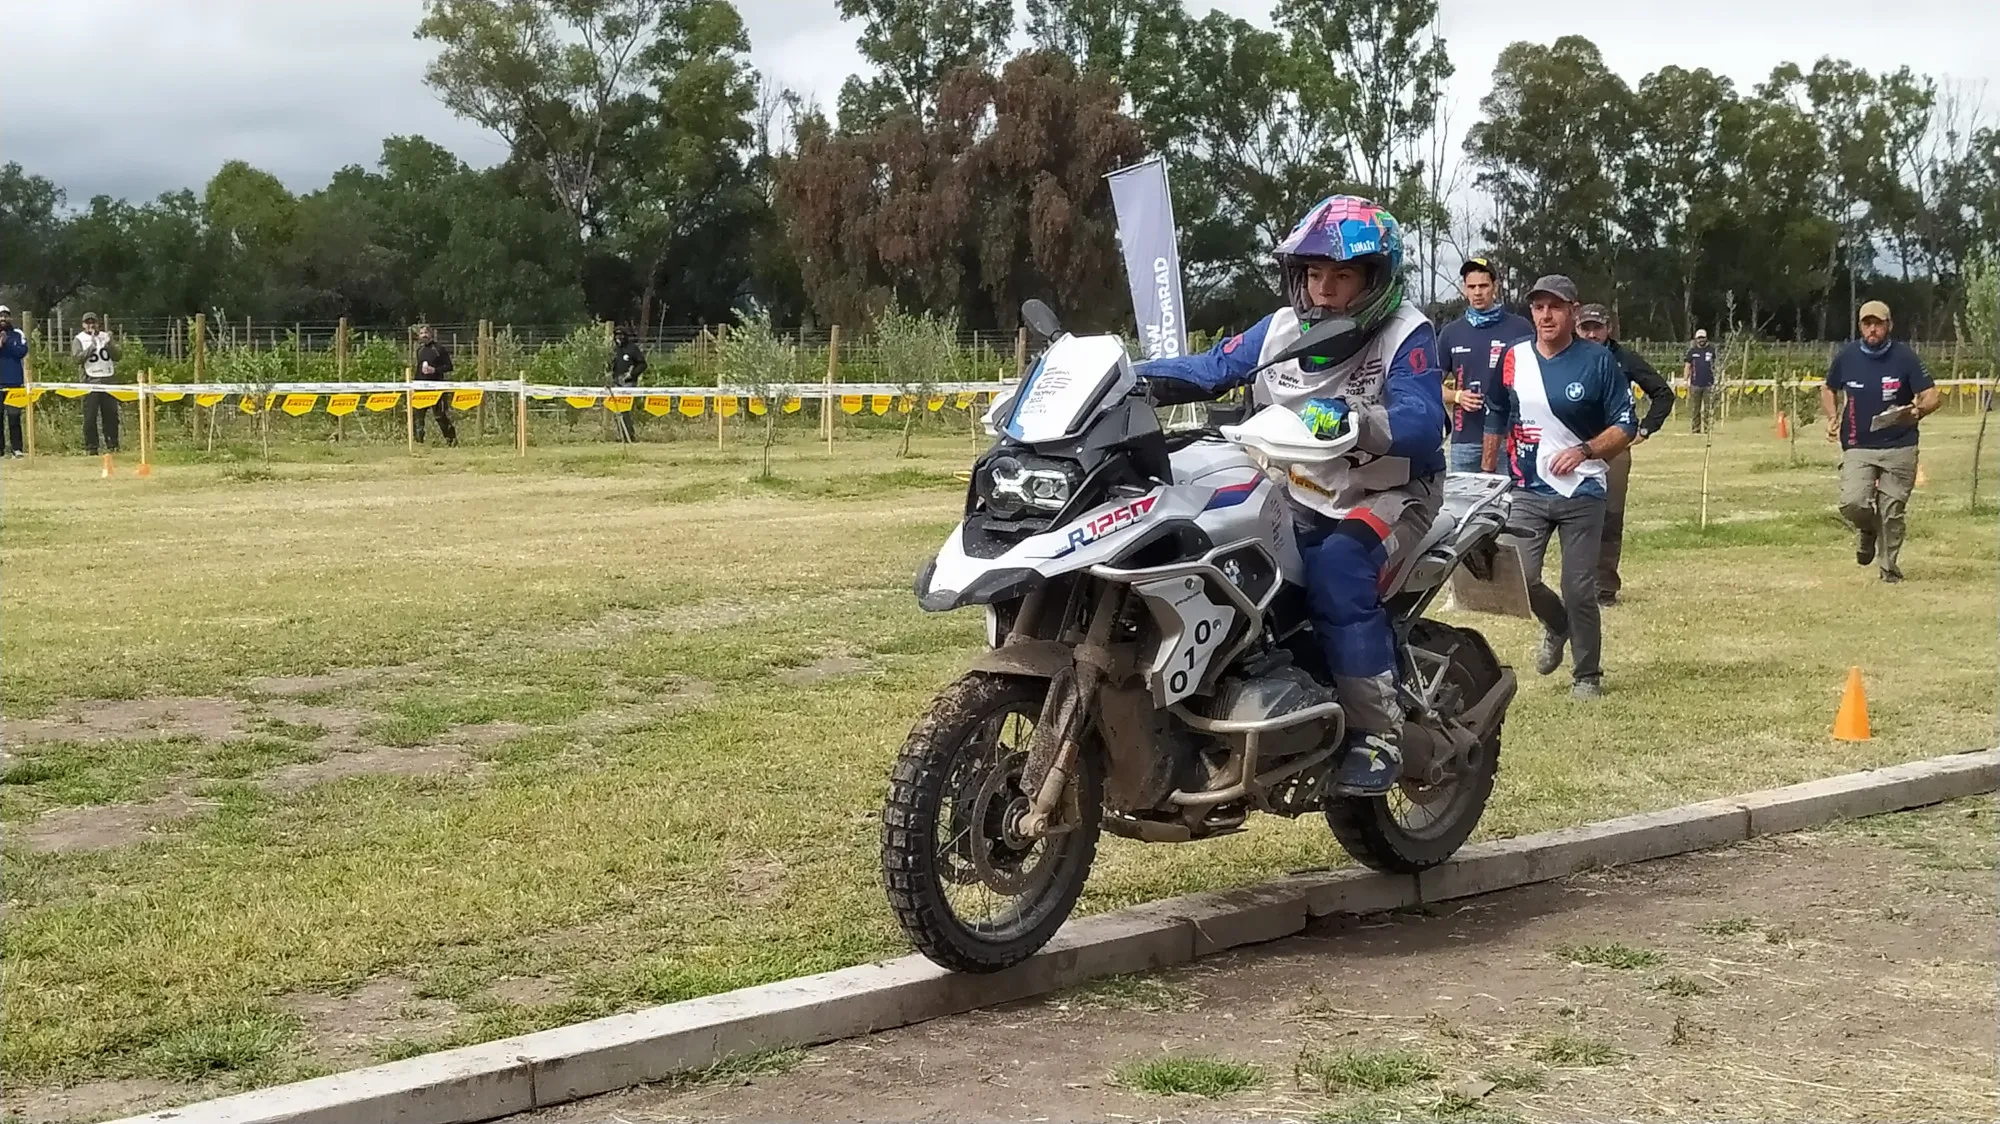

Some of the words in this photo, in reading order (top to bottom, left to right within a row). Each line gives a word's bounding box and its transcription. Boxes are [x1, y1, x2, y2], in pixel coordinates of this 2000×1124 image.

[1146, 324, 1162, 360] MW
[1280, 373, 1299, 384] BMW
[1345, 387, 1366, 396] 2022
